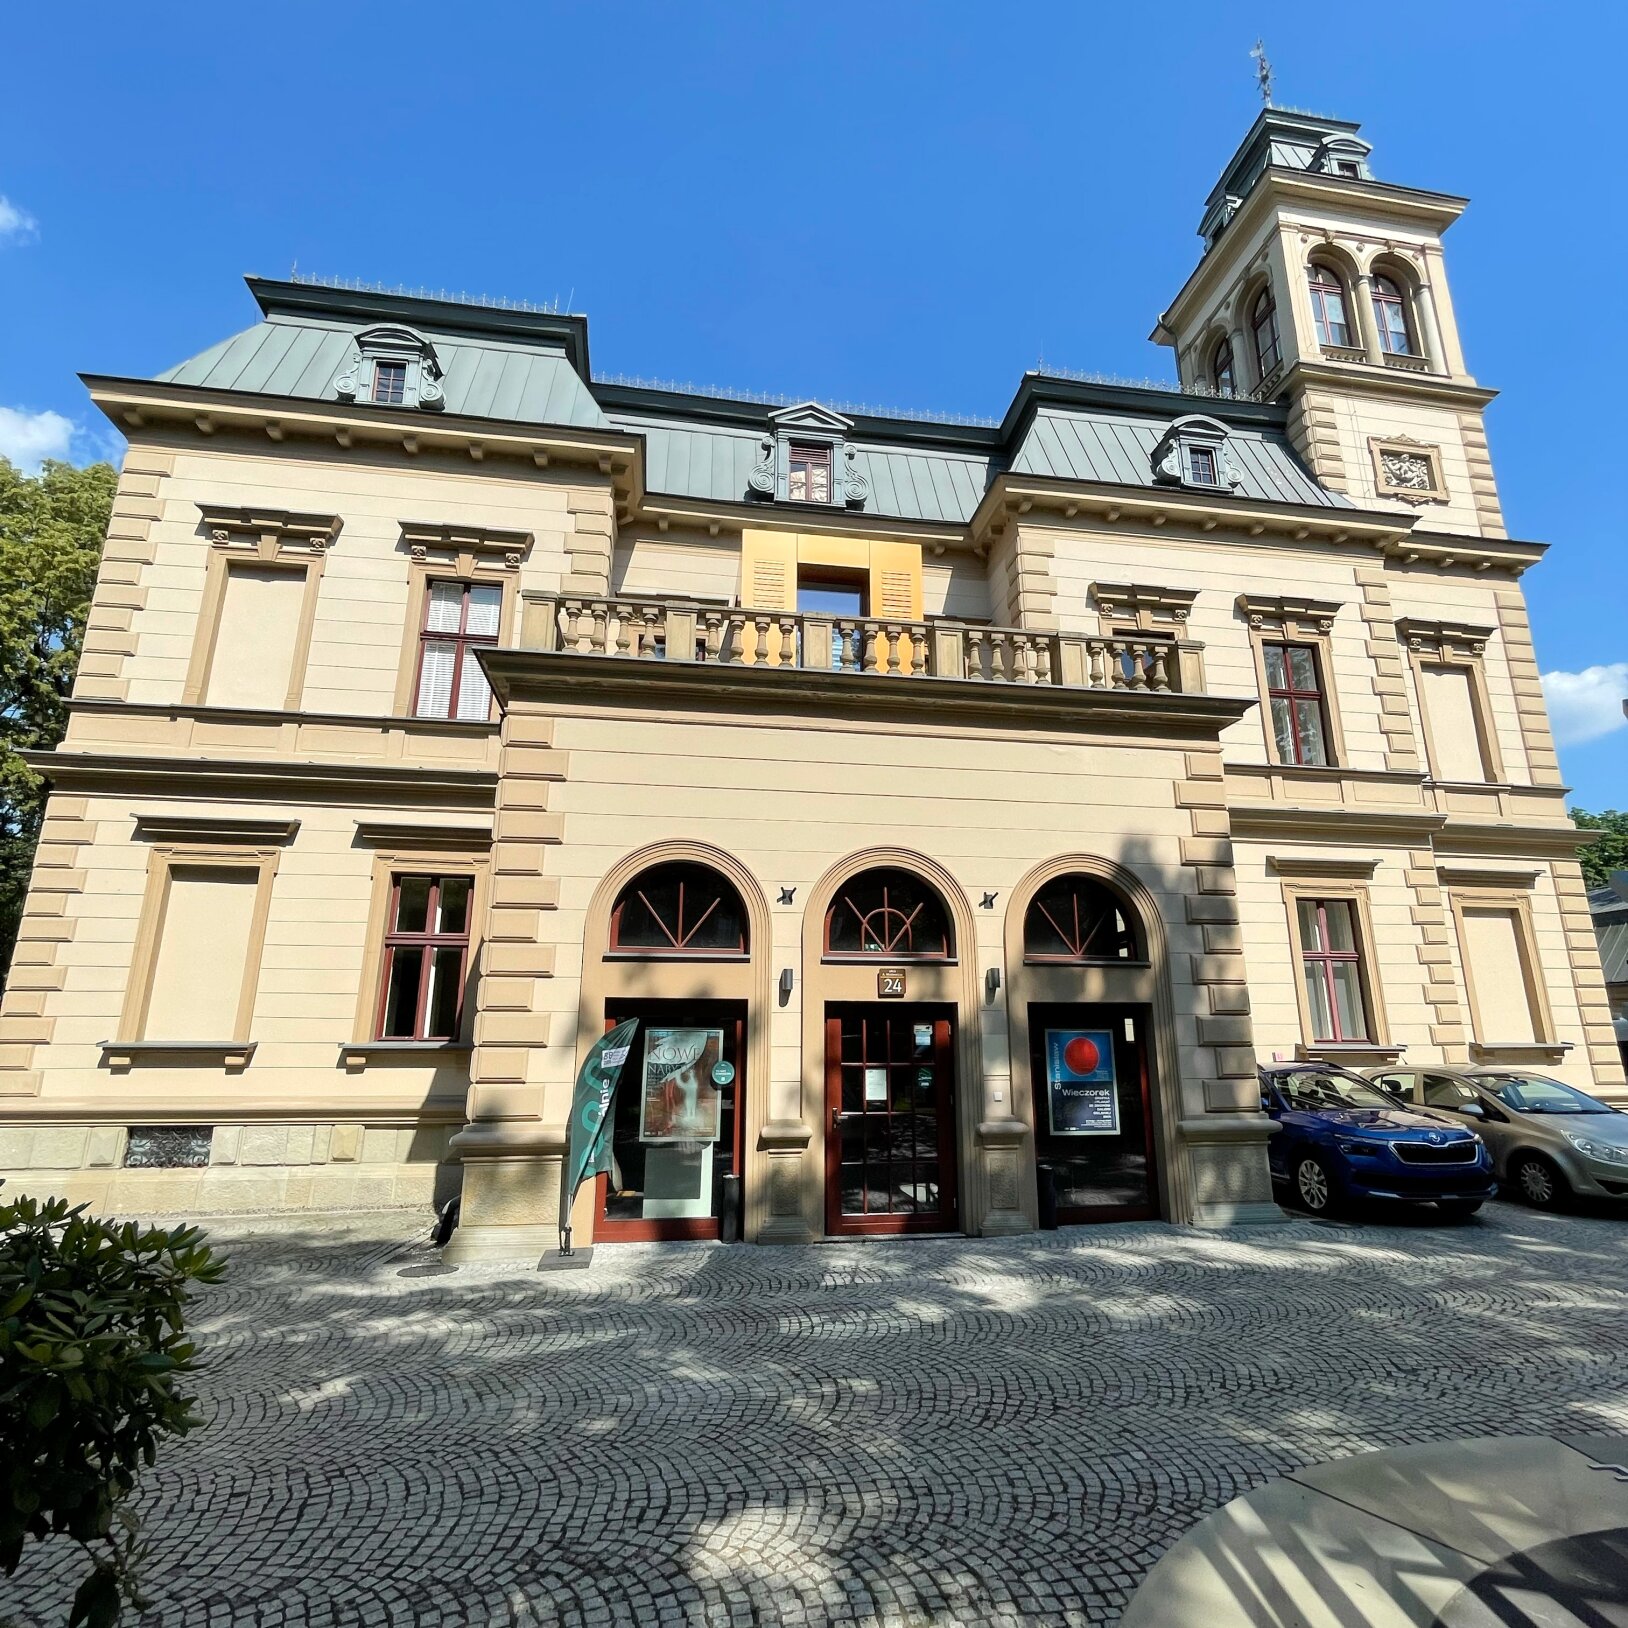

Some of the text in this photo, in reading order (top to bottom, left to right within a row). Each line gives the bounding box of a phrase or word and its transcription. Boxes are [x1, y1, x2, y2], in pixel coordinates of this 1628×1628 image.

[884, 978, 902, 993] 24
[648, 1045, 701, 1062] NOWE
[1062, 1088, 1111, 1097] Wieczorek
